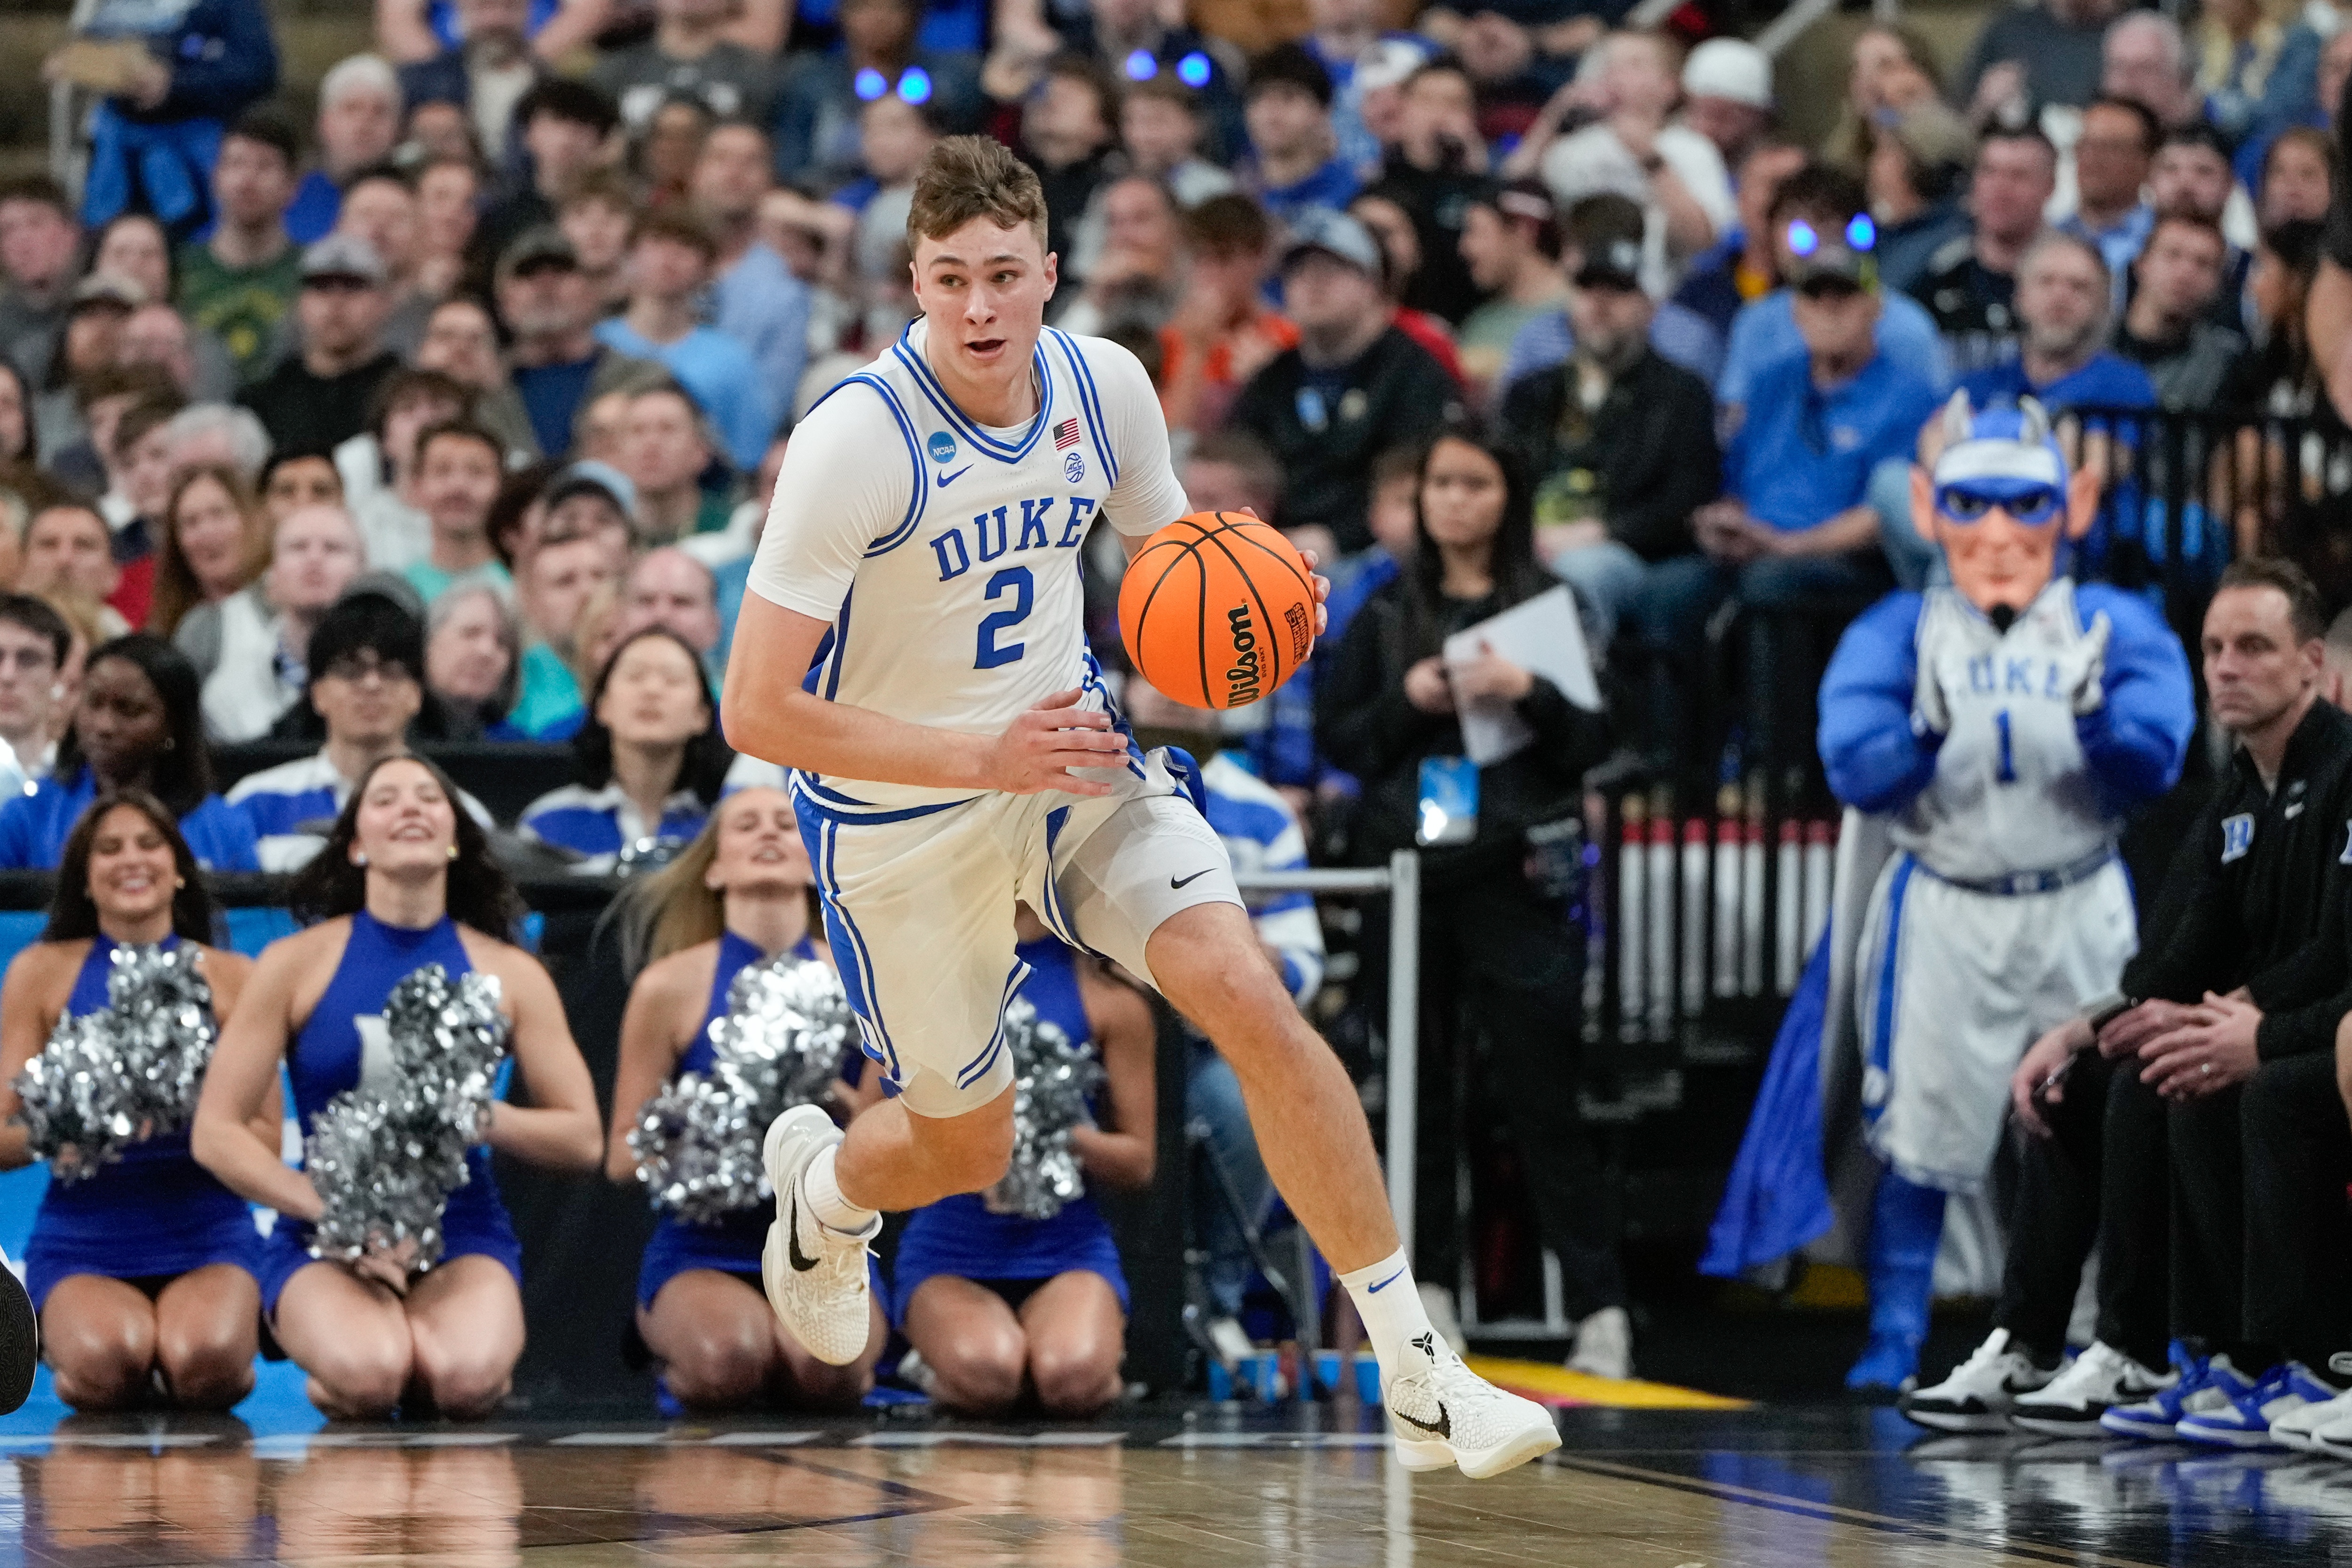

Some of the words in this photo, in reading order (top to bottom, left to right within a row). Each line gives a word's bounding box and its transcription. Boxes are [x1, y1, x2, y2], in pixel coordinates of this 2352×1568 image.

[932, 445, 955, 457] NCAA
[1066, 460, 1082, 473] ACC
[930, 496, 1095, 582] DUKE
[972, 566, 1034, 669] 2
[1292, 624, 1303, 655] MARCH
[1293, 603, 1308, 646] MADNESS
[1225, 603, 1261, 707] Wilson
[1994, 709, 2017, 783] 1
